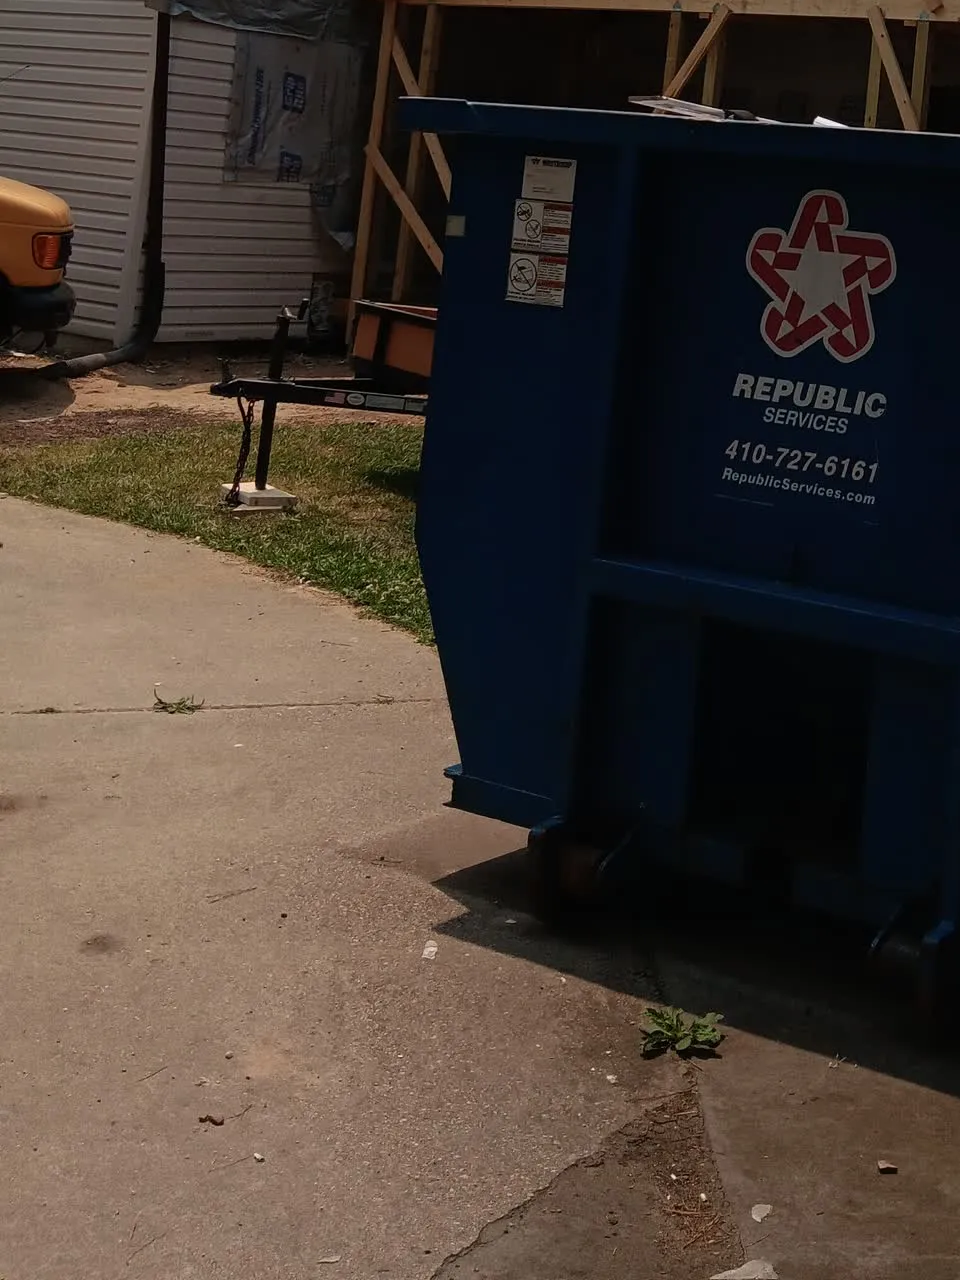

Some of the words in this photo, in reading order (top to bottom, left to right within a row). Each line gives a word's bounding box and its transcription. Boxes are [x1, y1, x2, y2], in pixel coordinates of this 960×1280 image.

[731, 372, 888, 419] REPUBLIC
[763, 407, 849, 434] SERVICES
[724, 439, 879, 483] 410-727-6161
[722, 467, 876, 505] RepublicServices.com
